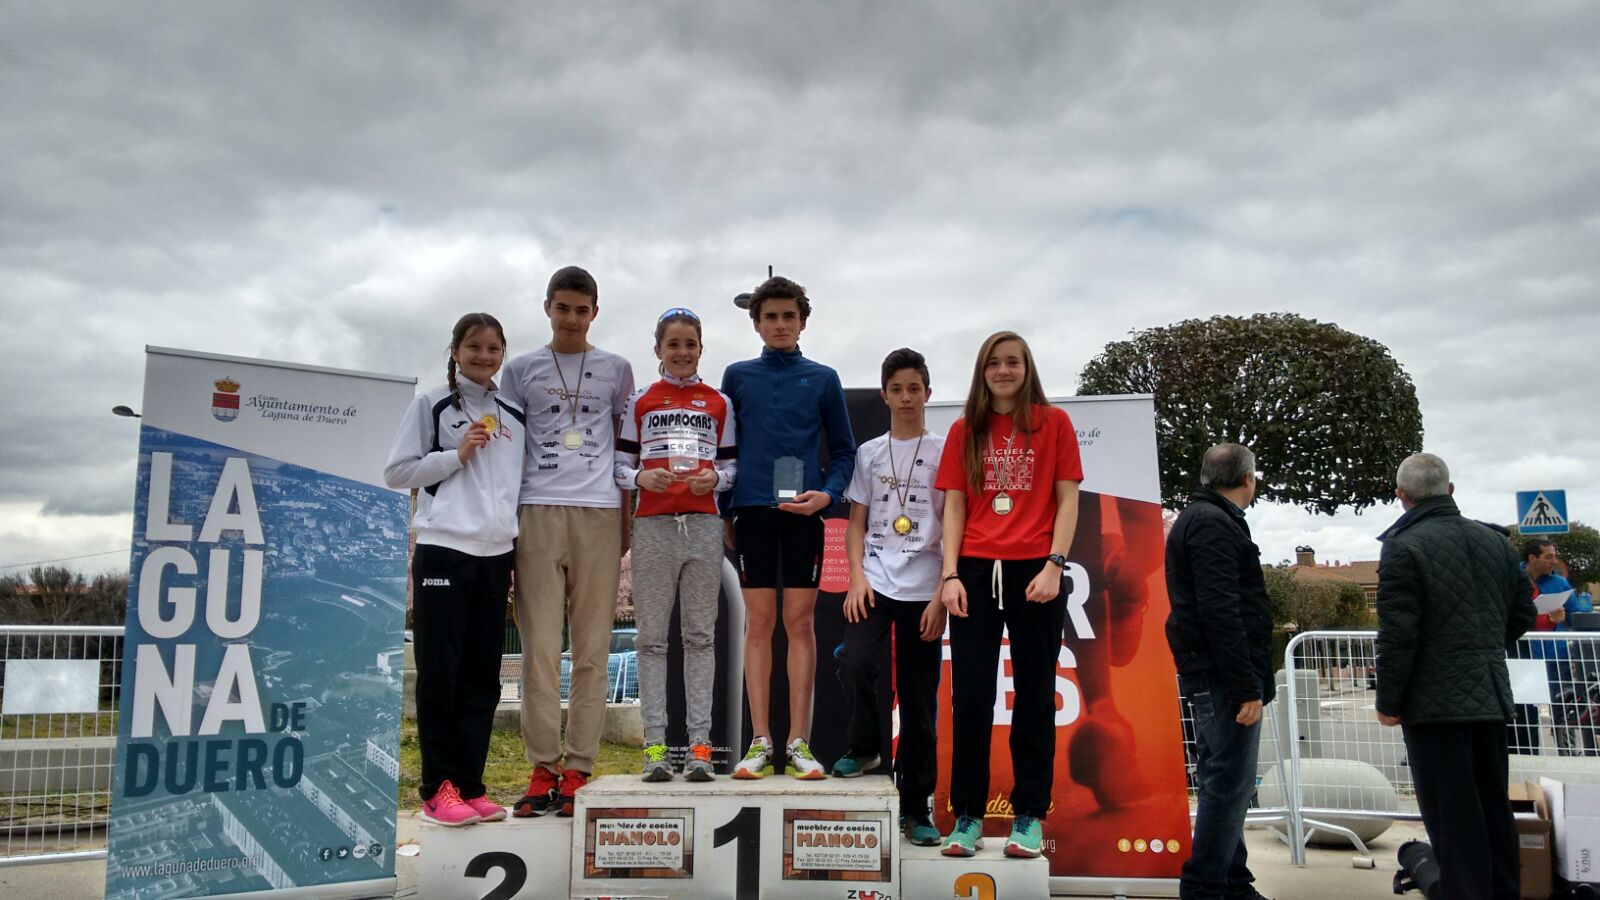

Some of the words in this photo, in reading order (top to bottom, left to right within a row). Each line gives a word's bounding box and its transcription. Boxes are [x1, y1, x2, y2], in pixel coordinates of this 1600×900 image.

[245, 396, 340, 415] Ayuntamiento
[342, 405, 357, 417] de
[261, 409, 300, 421] Laguna
[302, 413, 314, 422] de
[316, 415, 347, 425] Duero
[648, 413, 712, 430] JONPROCARS
[1088, 427, 1101, 438] de
[146, 452, 265, 545] LA
[138, 546, 264, 639] GU
[131, 643, 266, 738] NA
[269, 702, 307, 733] DE
[123, 736, 305, 798] DUERO
[649, 822, 678, 830] cocina
[599, 831, 681, 846] MANOLO
[796, 832, 878, 849] MANOLO
[120, 855, 260, 879] www.lagunadeduero.org
